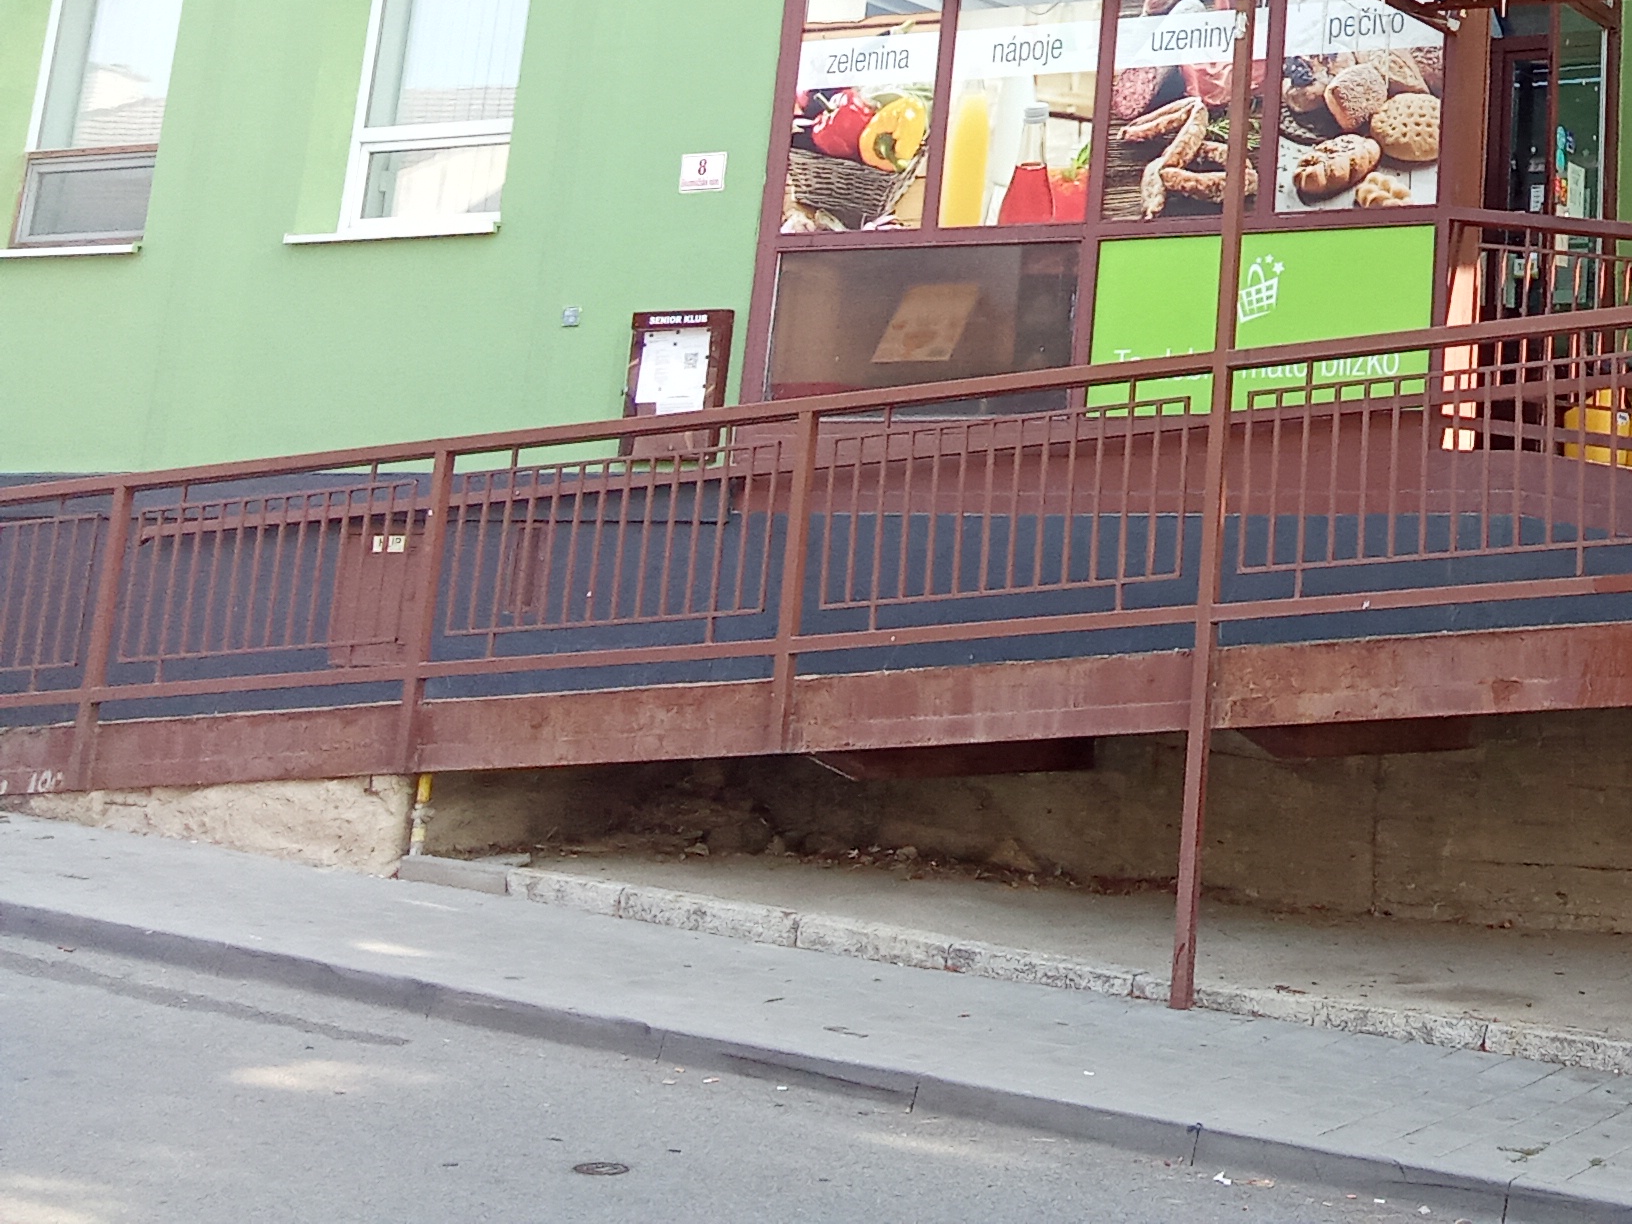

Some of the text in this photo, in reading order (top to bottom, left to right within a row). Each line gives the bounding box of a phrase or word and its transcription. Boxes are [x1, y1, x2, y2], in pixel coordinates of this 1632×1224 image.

[1151, 21, 1236, 53] uzeniny
[1329, 7, 1404, 44] pečivo
[826, 45, 910, 74] zelenina
[992, 35, 1063, 67] nápoje
[697, 158, 708, 176] 8
[648, 314, 708, 325] SENIOR KLUB
